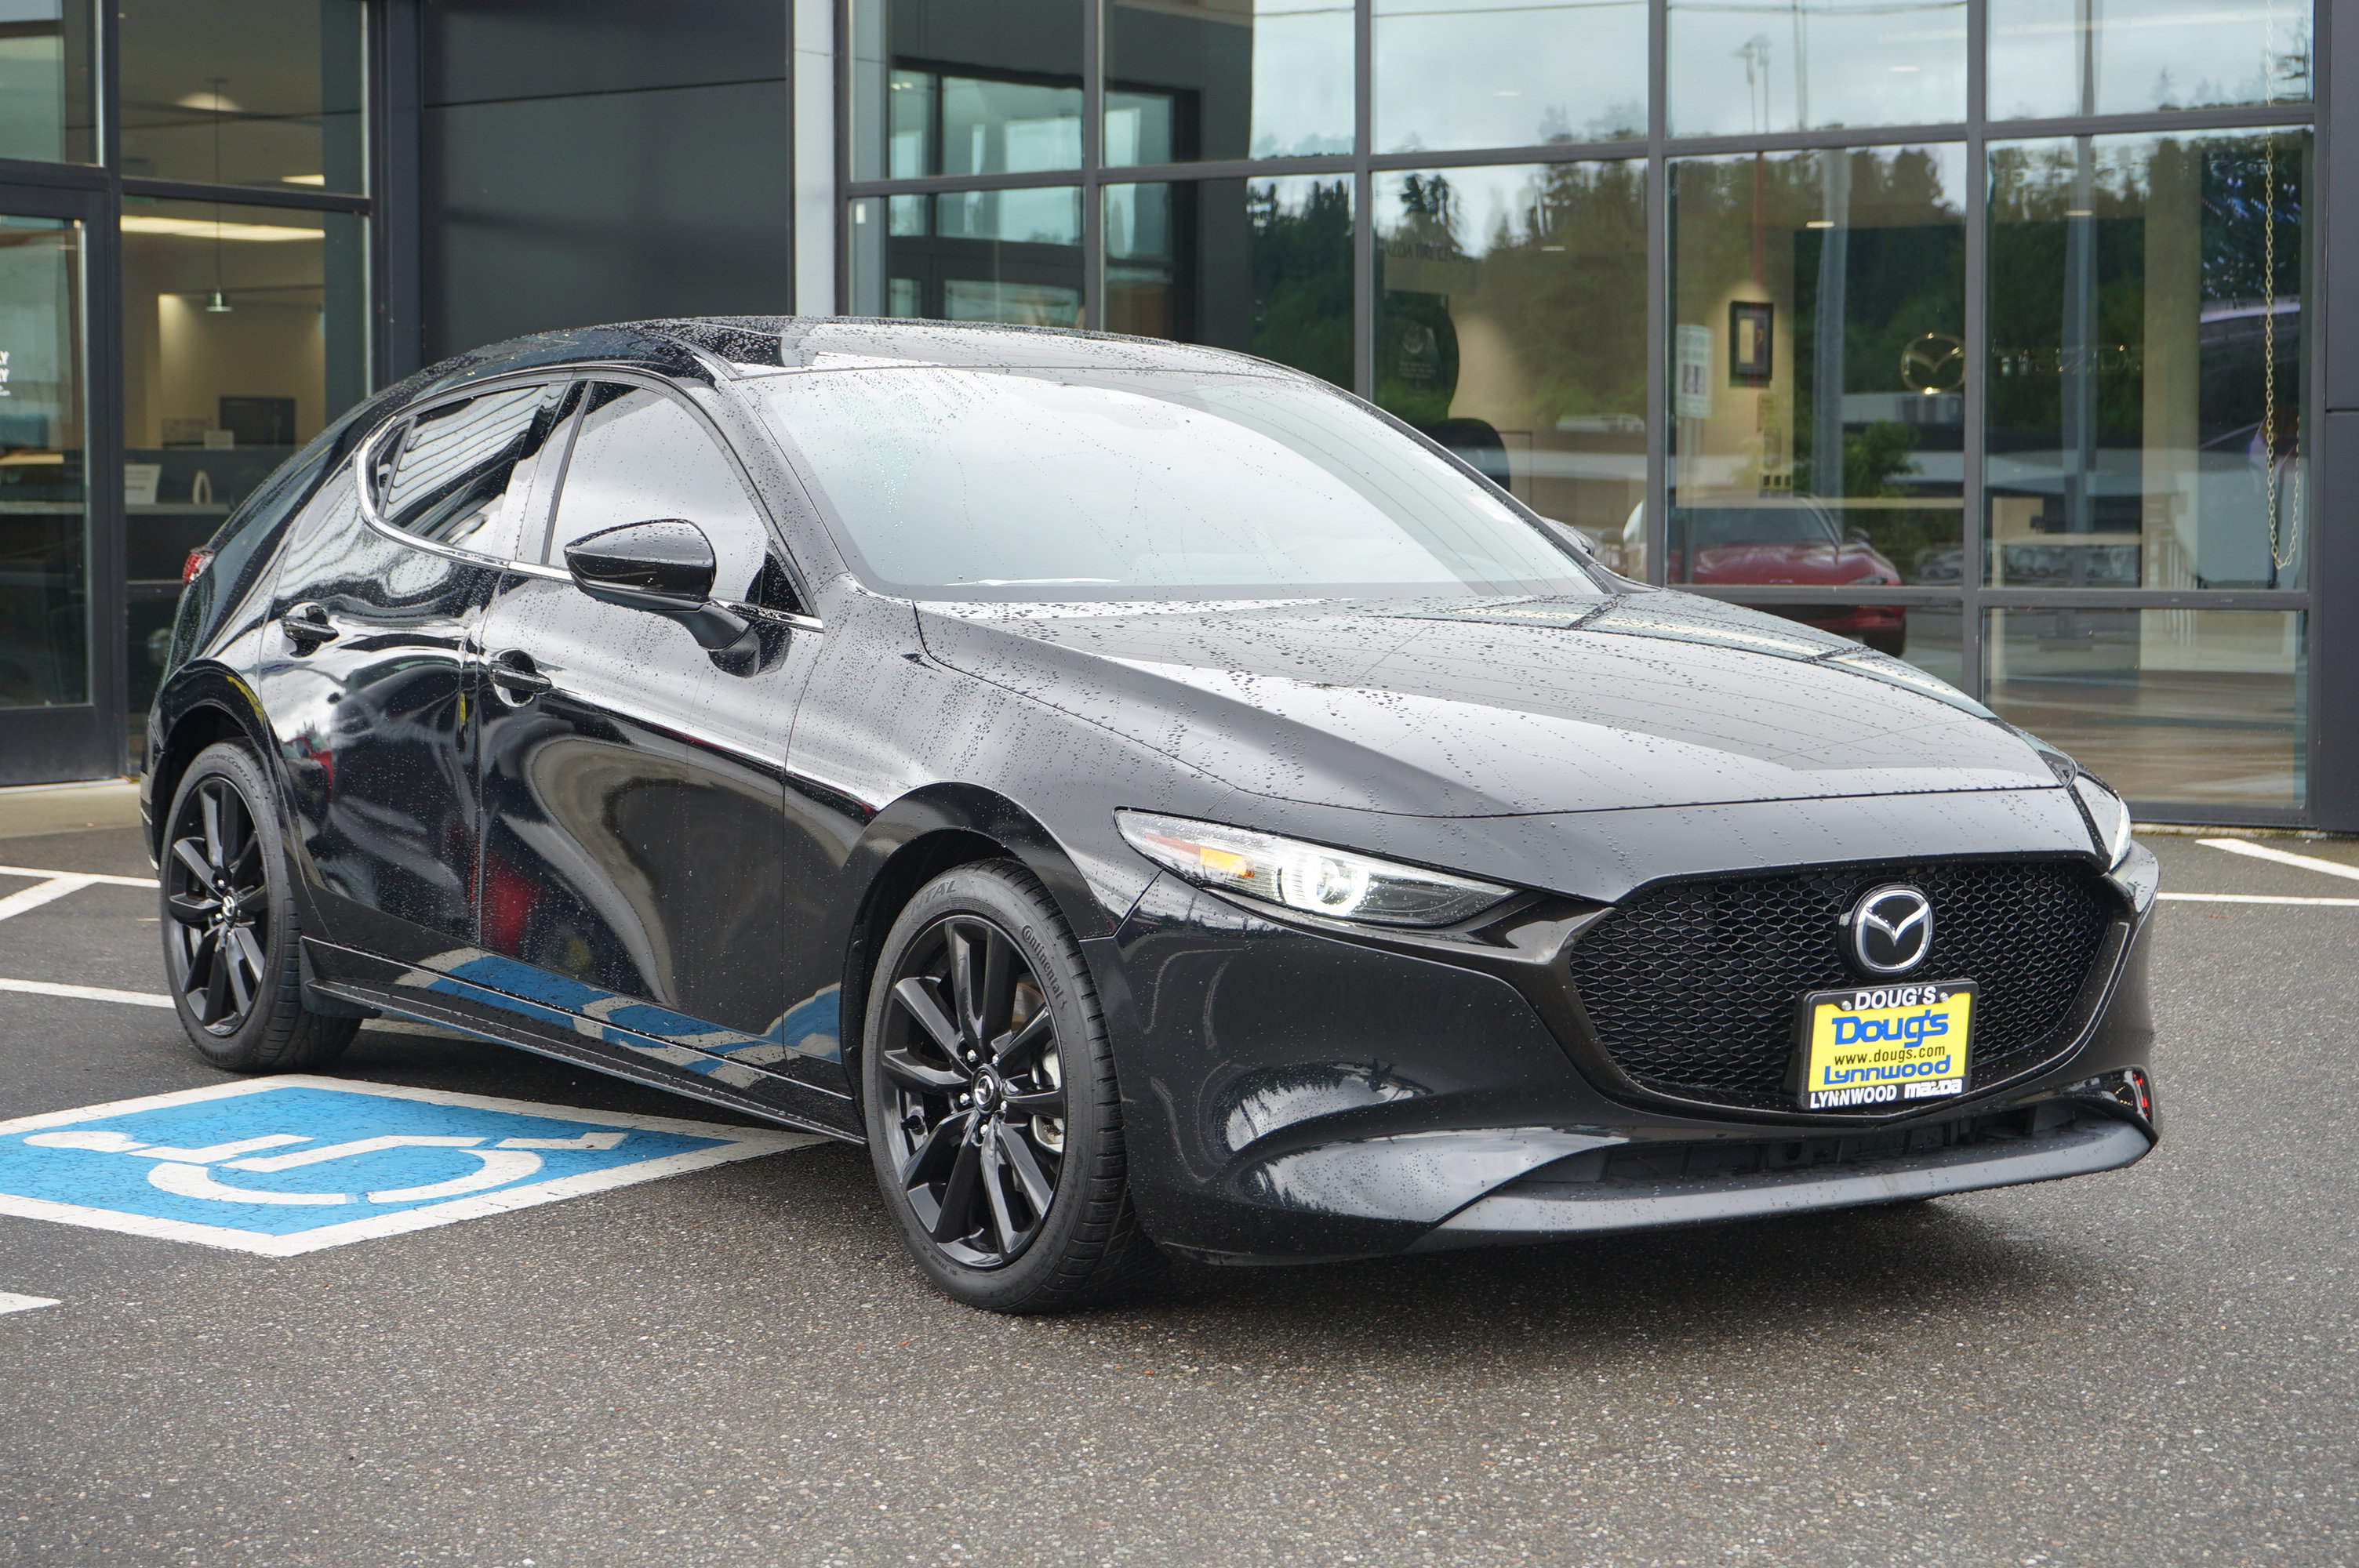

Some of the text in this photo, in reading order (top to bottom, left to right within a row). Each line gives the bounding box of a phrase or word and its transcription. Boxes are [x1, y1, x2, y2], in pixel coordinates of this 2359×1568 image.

[1021, 924, 1064, 1000] Continental
[1854, 986, 1936, 1011] DOUG'S
[1832, 1009, 1949, 1048] Doug's
[1823, 1054, 1951, 1085] Lynnwood
[1834, 1045, 1946, 1066] www.dougs.com
[1809, 1084, 1898, 1109] LYNNWOOD
